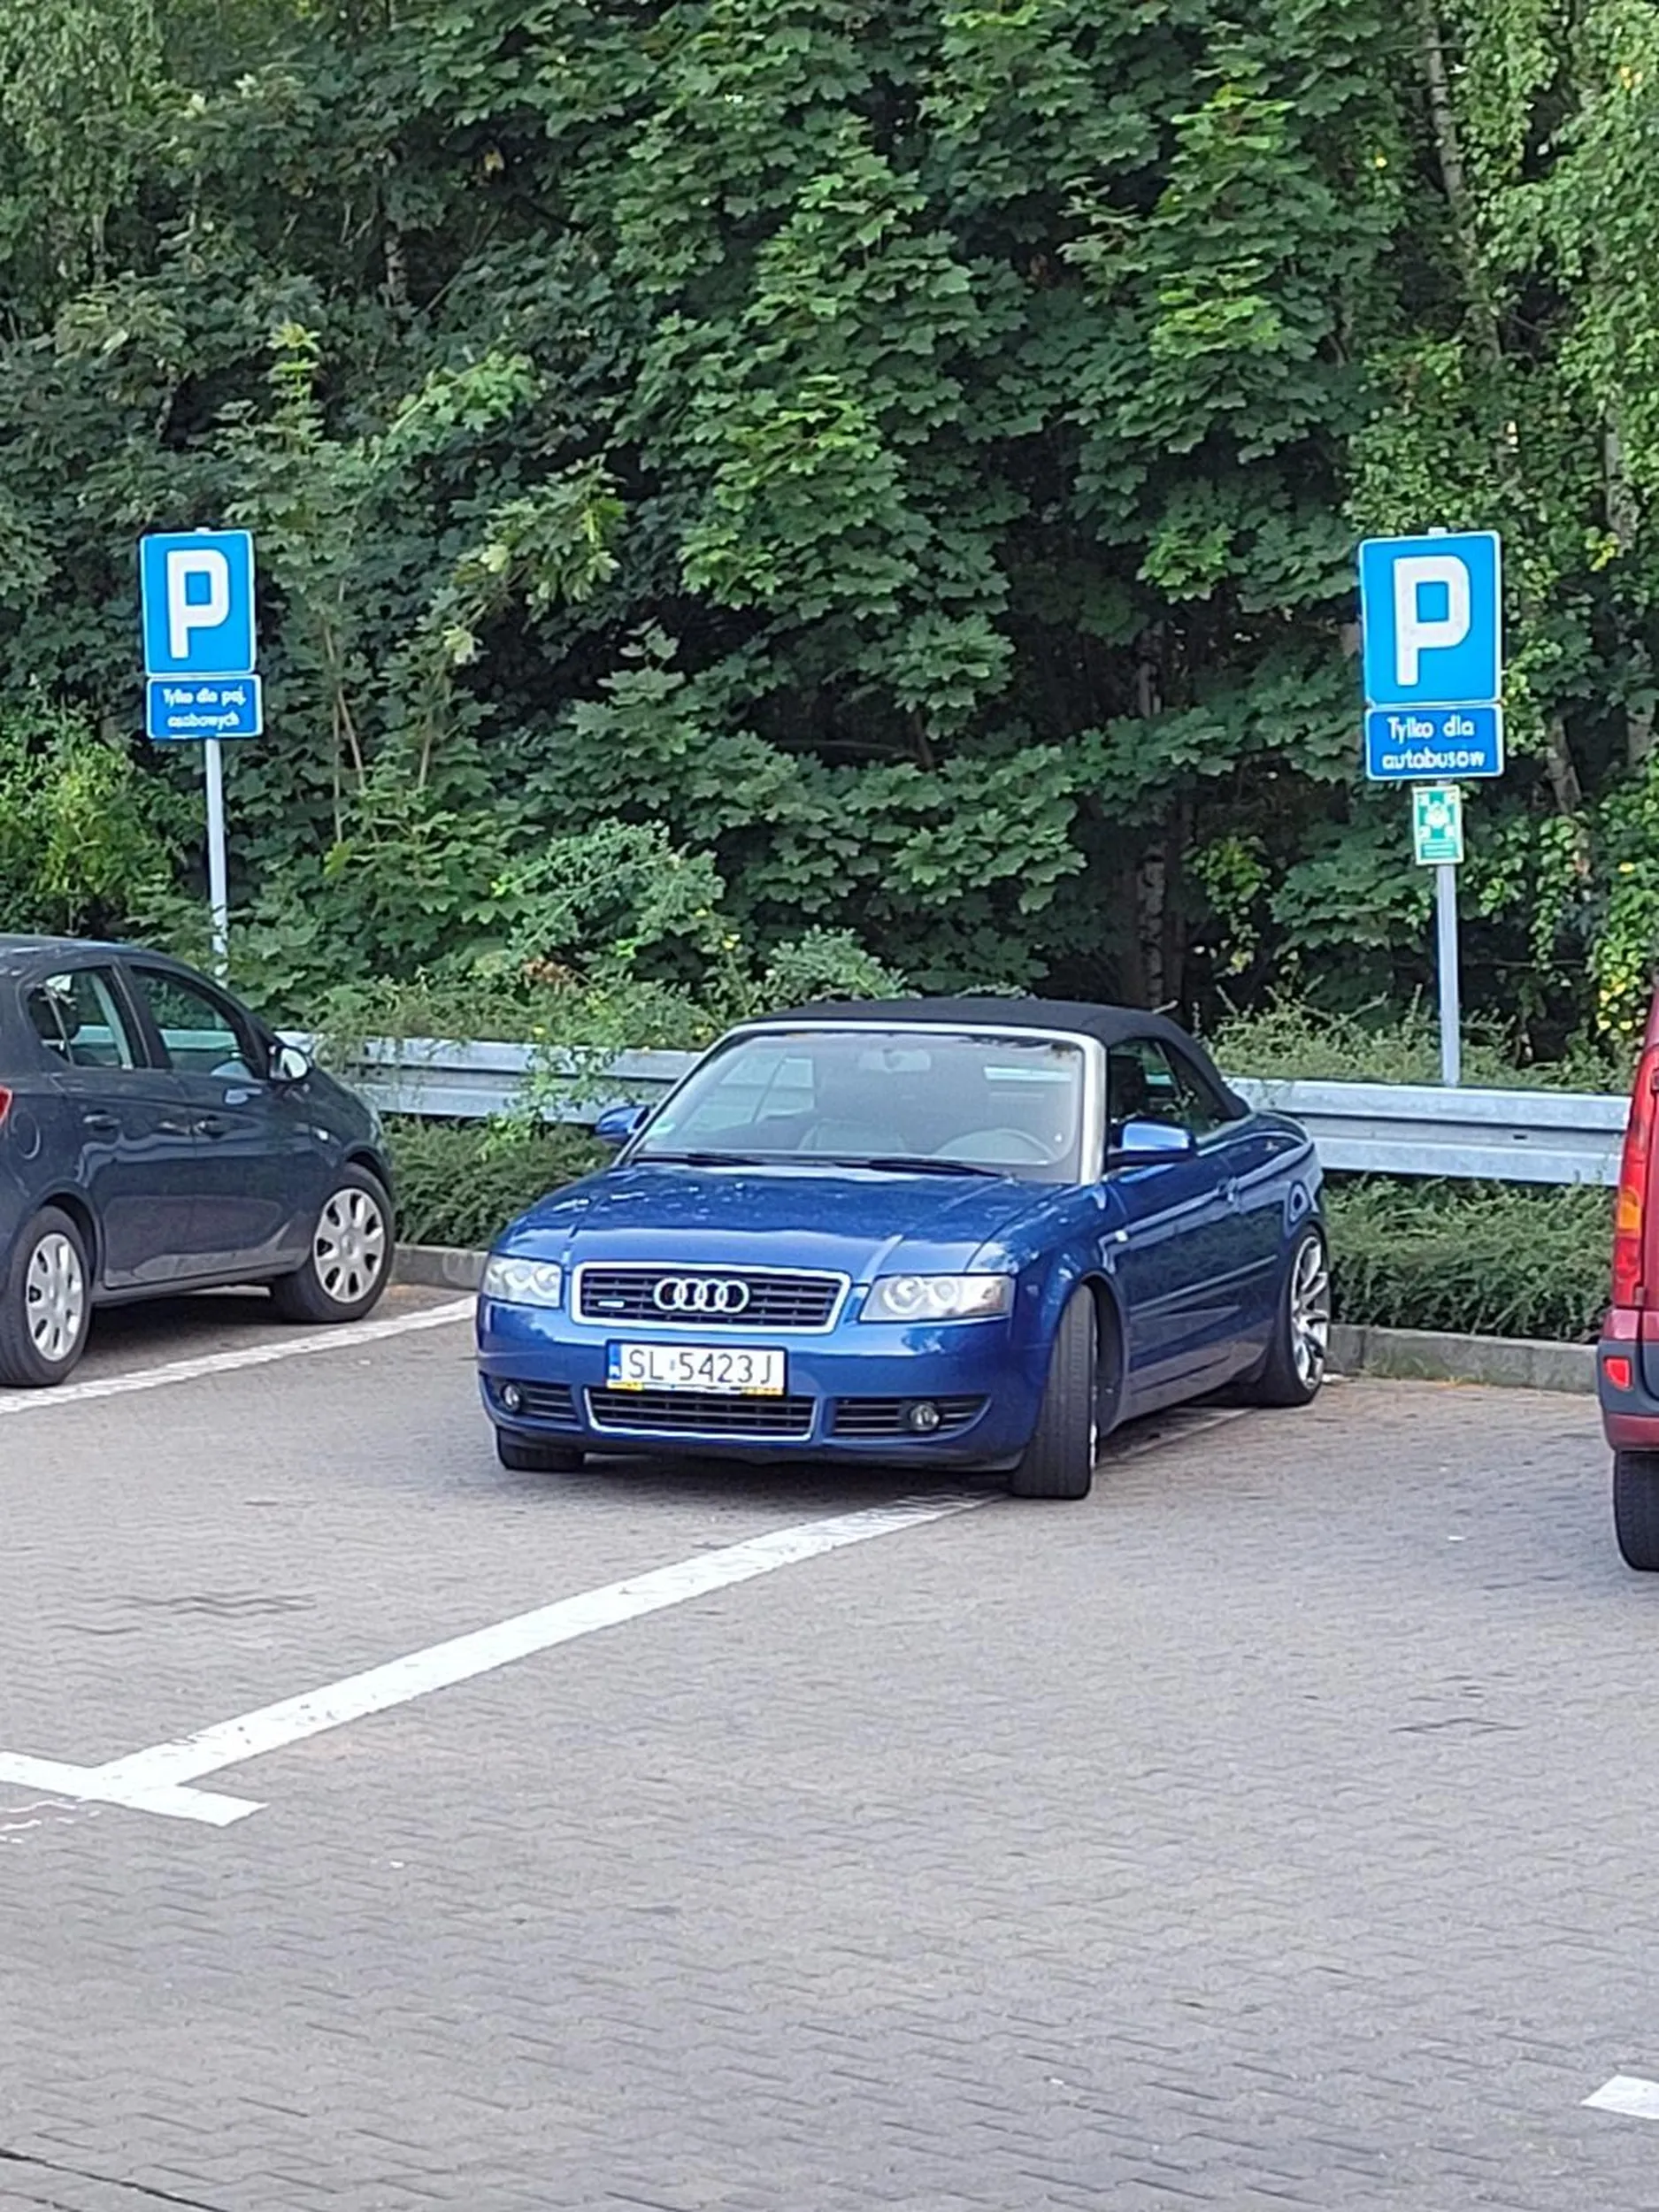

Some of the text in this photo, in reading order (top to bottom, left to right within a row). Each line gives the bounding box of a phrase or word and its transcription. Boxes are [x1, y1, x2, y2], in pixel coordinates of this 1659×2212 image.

[166, 549, 229, 658] P
[1393, 555, 1471, 686] P
[1386, 714, 1475, 744] Tylko dla
[628, 1348, 772, 1385] SL 5423J
